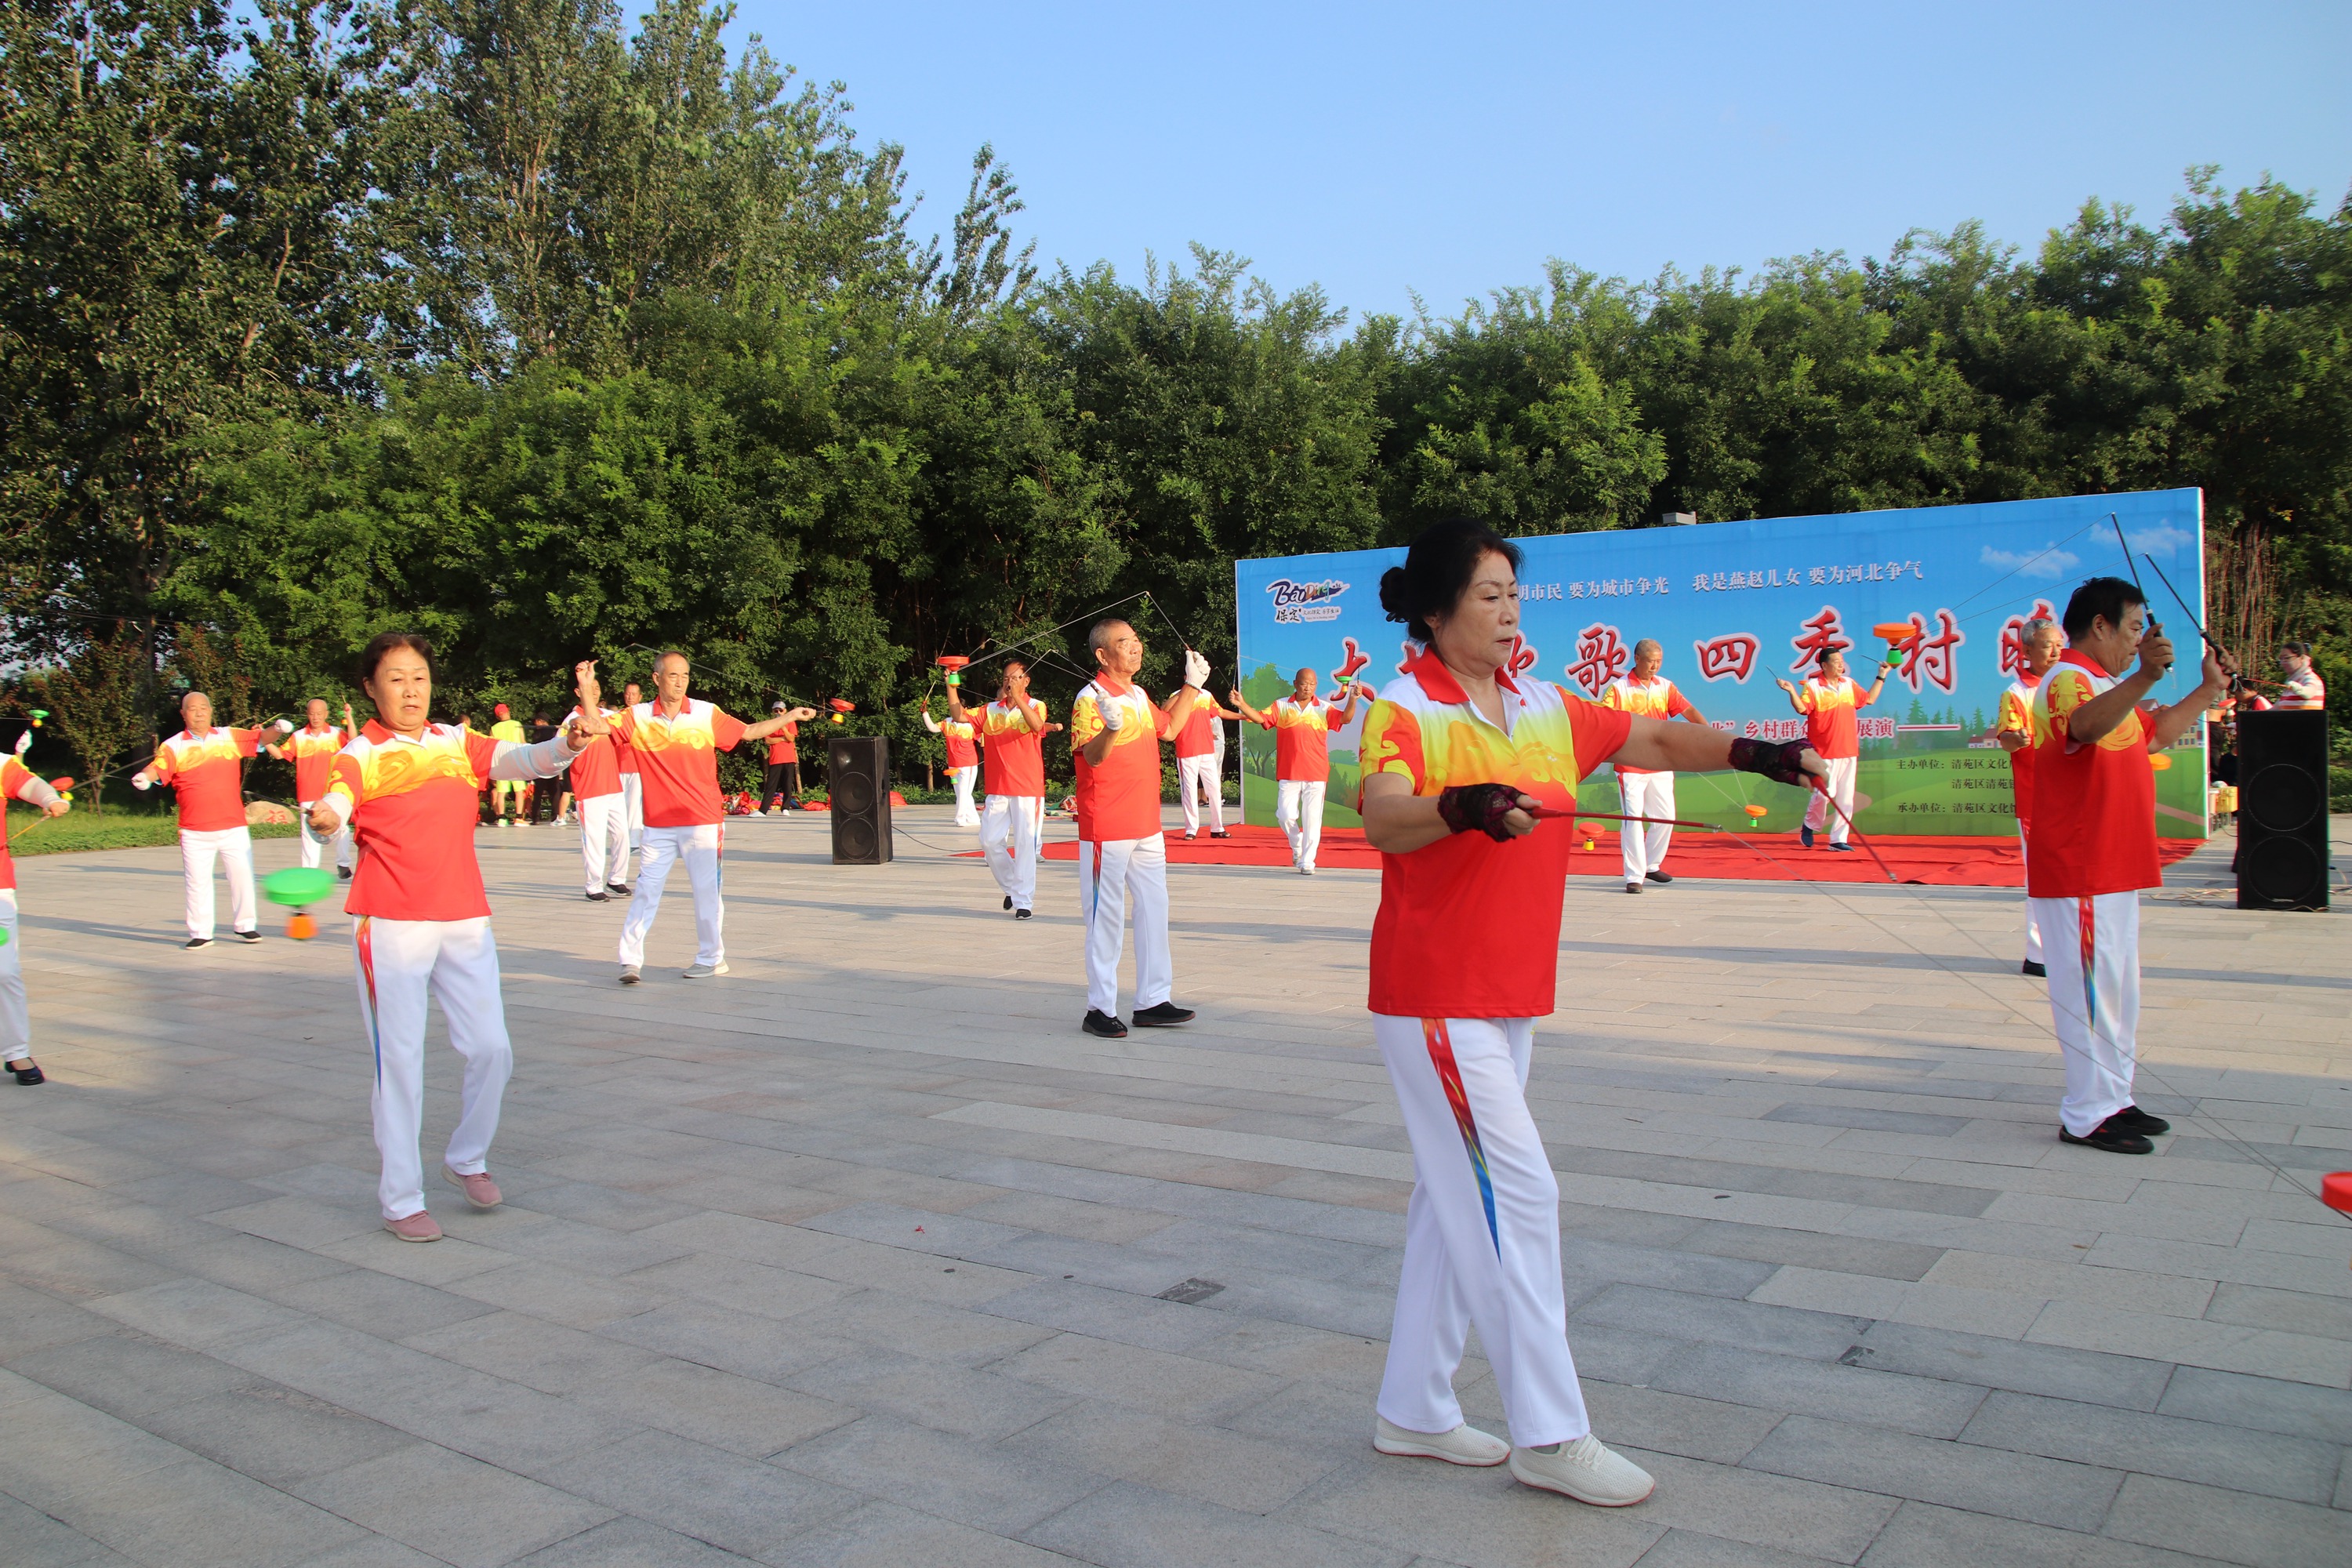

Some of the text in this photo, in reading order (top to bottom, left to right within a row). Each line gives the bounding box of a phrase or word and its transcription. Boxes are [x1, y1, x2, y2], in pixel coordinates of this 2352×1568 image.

[1568, 576, 1669, 601] 要为城市争光
[1692, 568, 1801, 593] 我是燕赵儿女
[1807, 561, 1923, 586] 要为河北争气
[1276, 608, 1300, 622] 保定
